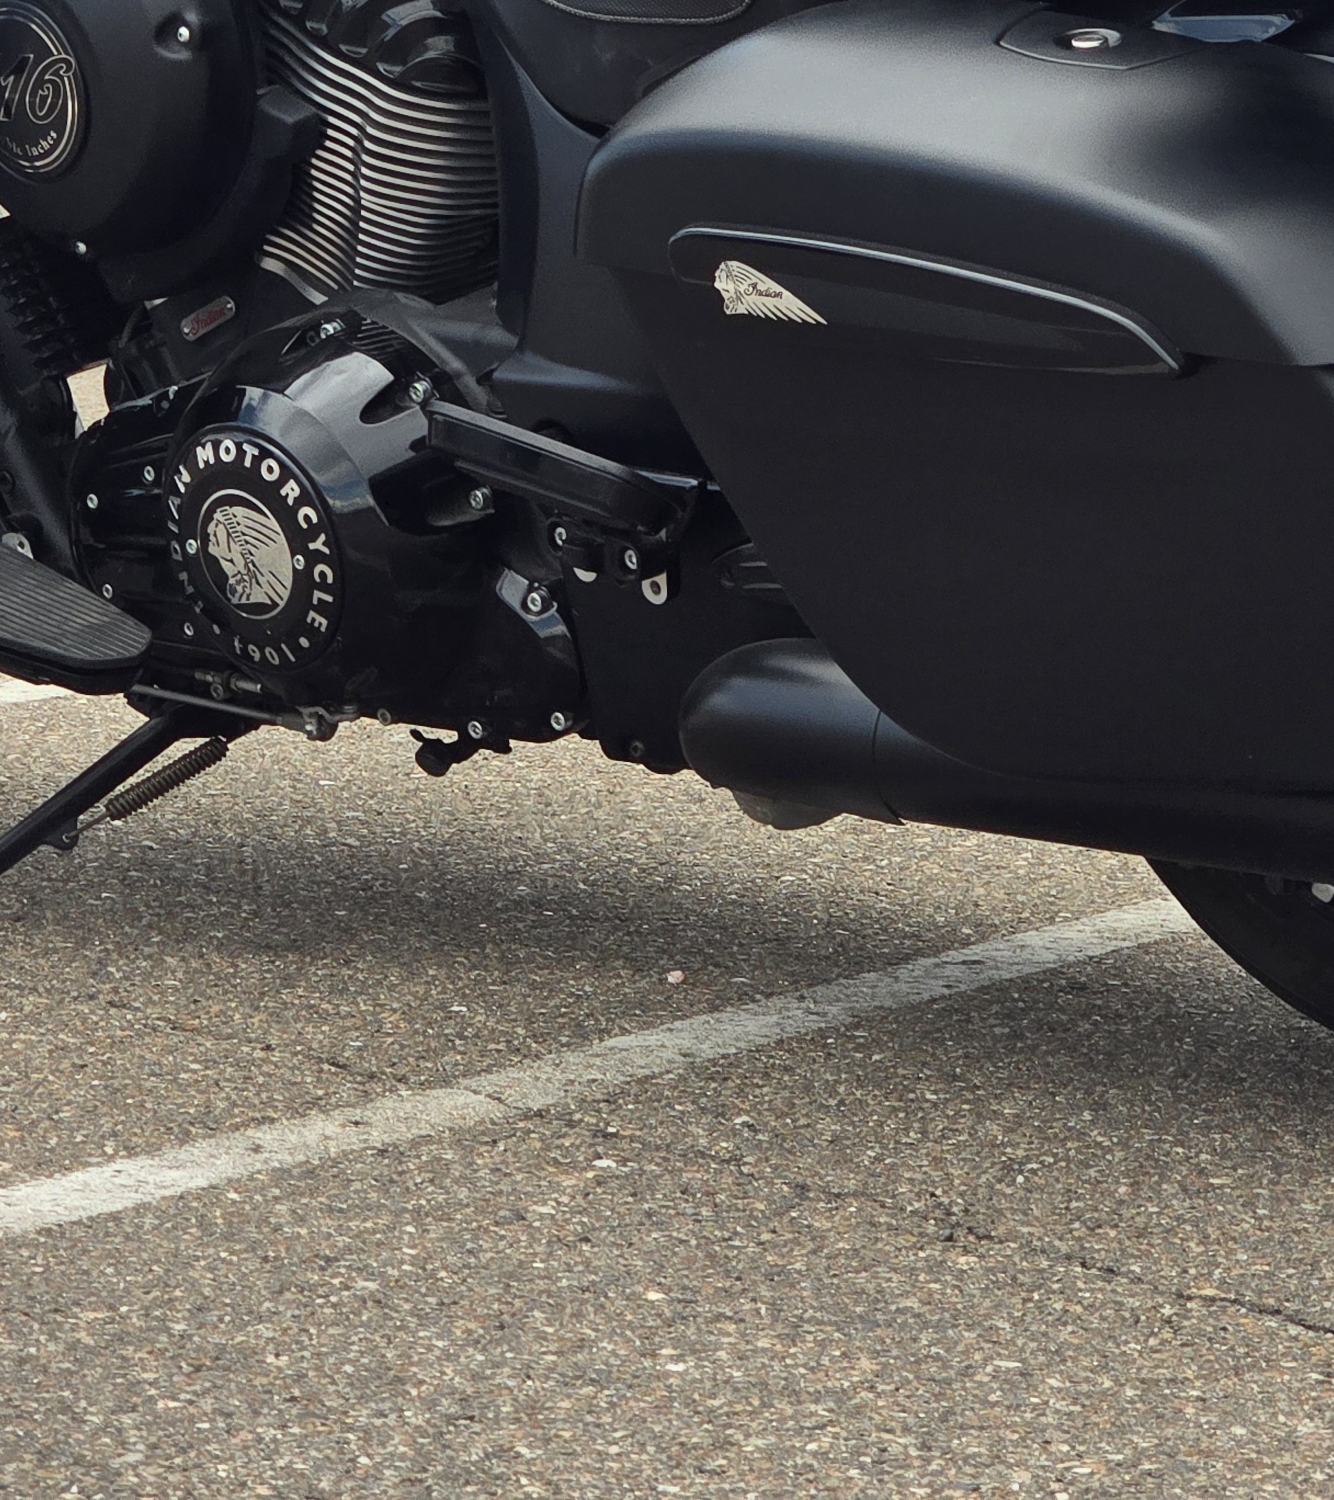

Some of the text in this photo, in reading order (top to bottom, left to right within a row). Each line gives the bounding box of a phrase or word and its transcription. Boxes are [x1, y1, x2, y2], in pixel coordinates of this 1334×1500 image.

[25, 129, 58, 157] Inches
[743, 281, 784, 300] Indian
[195, 438, 335, 633] MOTORCYCLE
